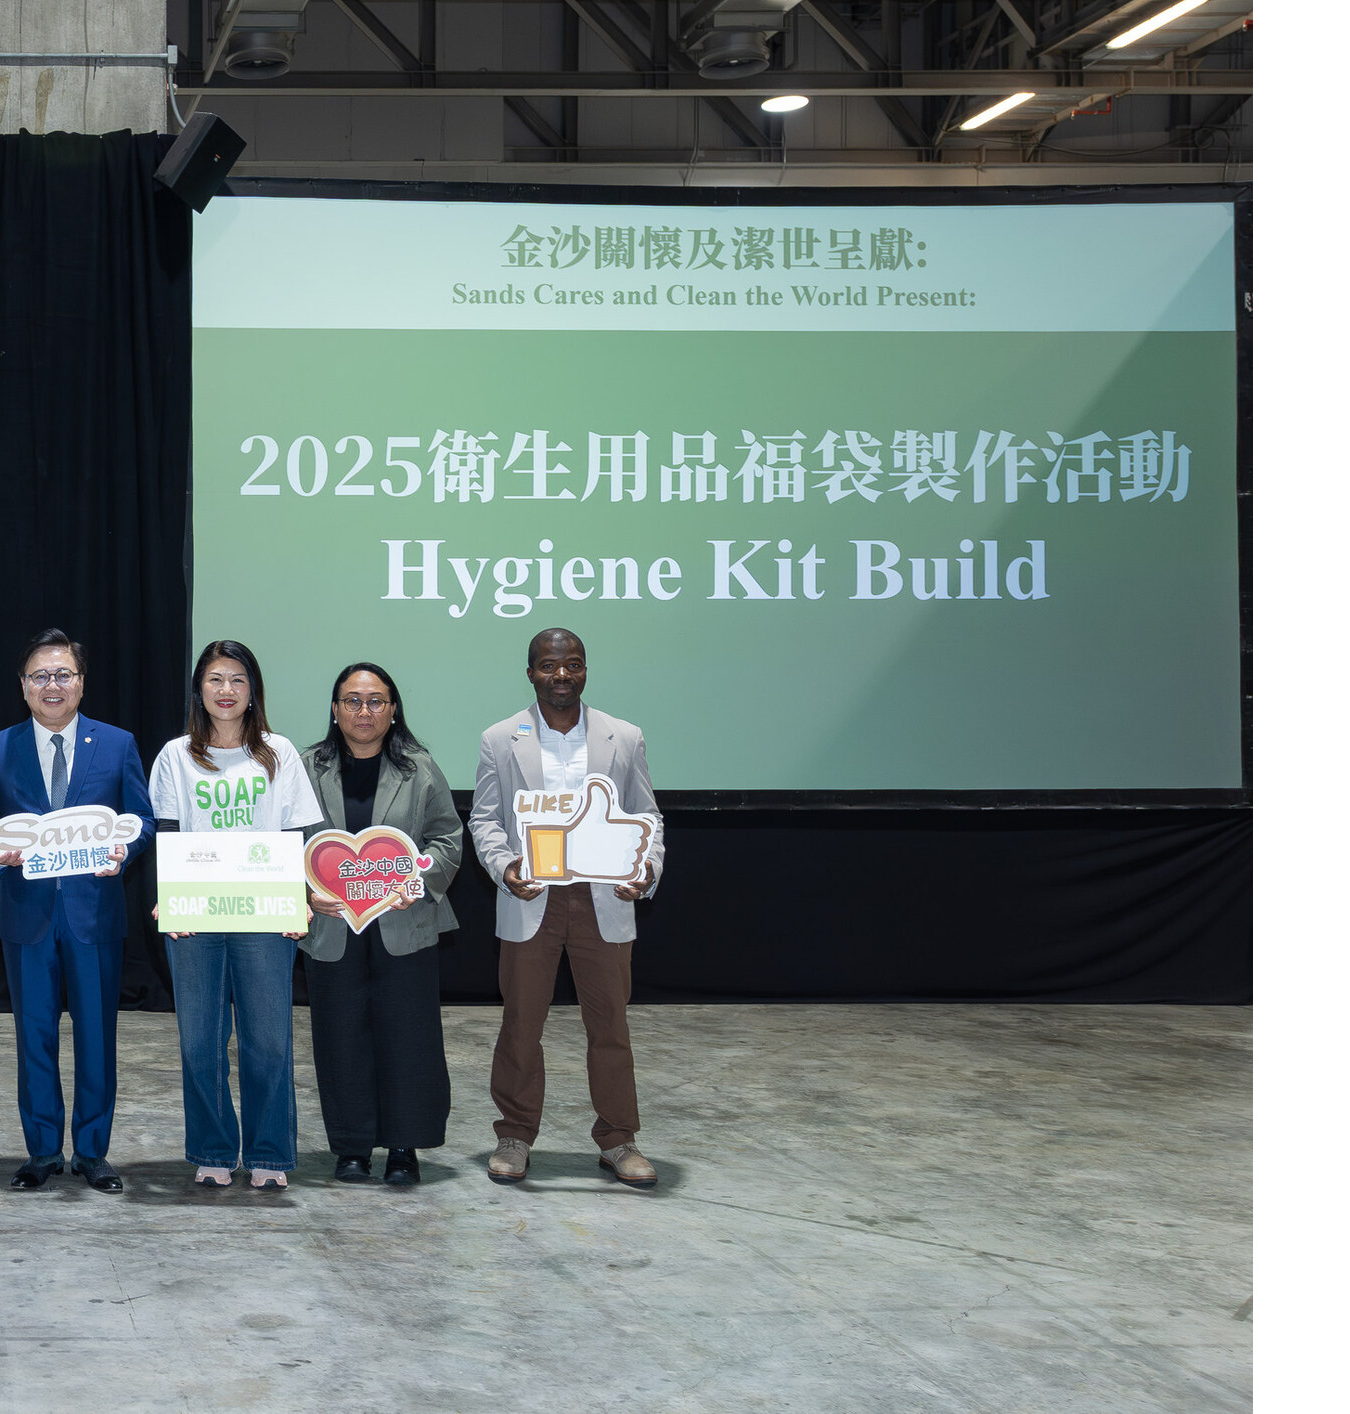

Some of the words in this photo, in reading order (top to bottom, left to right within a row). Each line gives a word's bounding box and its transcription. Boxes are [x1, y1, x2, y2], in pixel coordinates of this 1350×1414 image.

[500, 224, 928, 271] 金沙關懷及潔世呈獻:
[453, 283, 525, 307] Sands
[534, 283, 604, 307] Cares
[613, 283, 657, 307] and
[667, 283, 737, 307] Clean
[746, 283, 783, 307] the
[791, 283, 868, 307] World
[877, 283, 976, 307] Present:
[240, 428, 1193, 504] 2025衛生用品福袋製作活動
[380, 538, 682, 618] Hygiene
[706, 539, 826, 600] Kit
[849, 539, 1050, 600] Build
[195, 776, 266, 810] SOAP
[517, 794, 574, 813] LIKE
[211, 807, 254, 829] GURU
[26, 846, 112, 875] 金沙關懷
[339, 856, 413, 877] 金沙中國
[346, 879, 422, 900] 關懷大使
